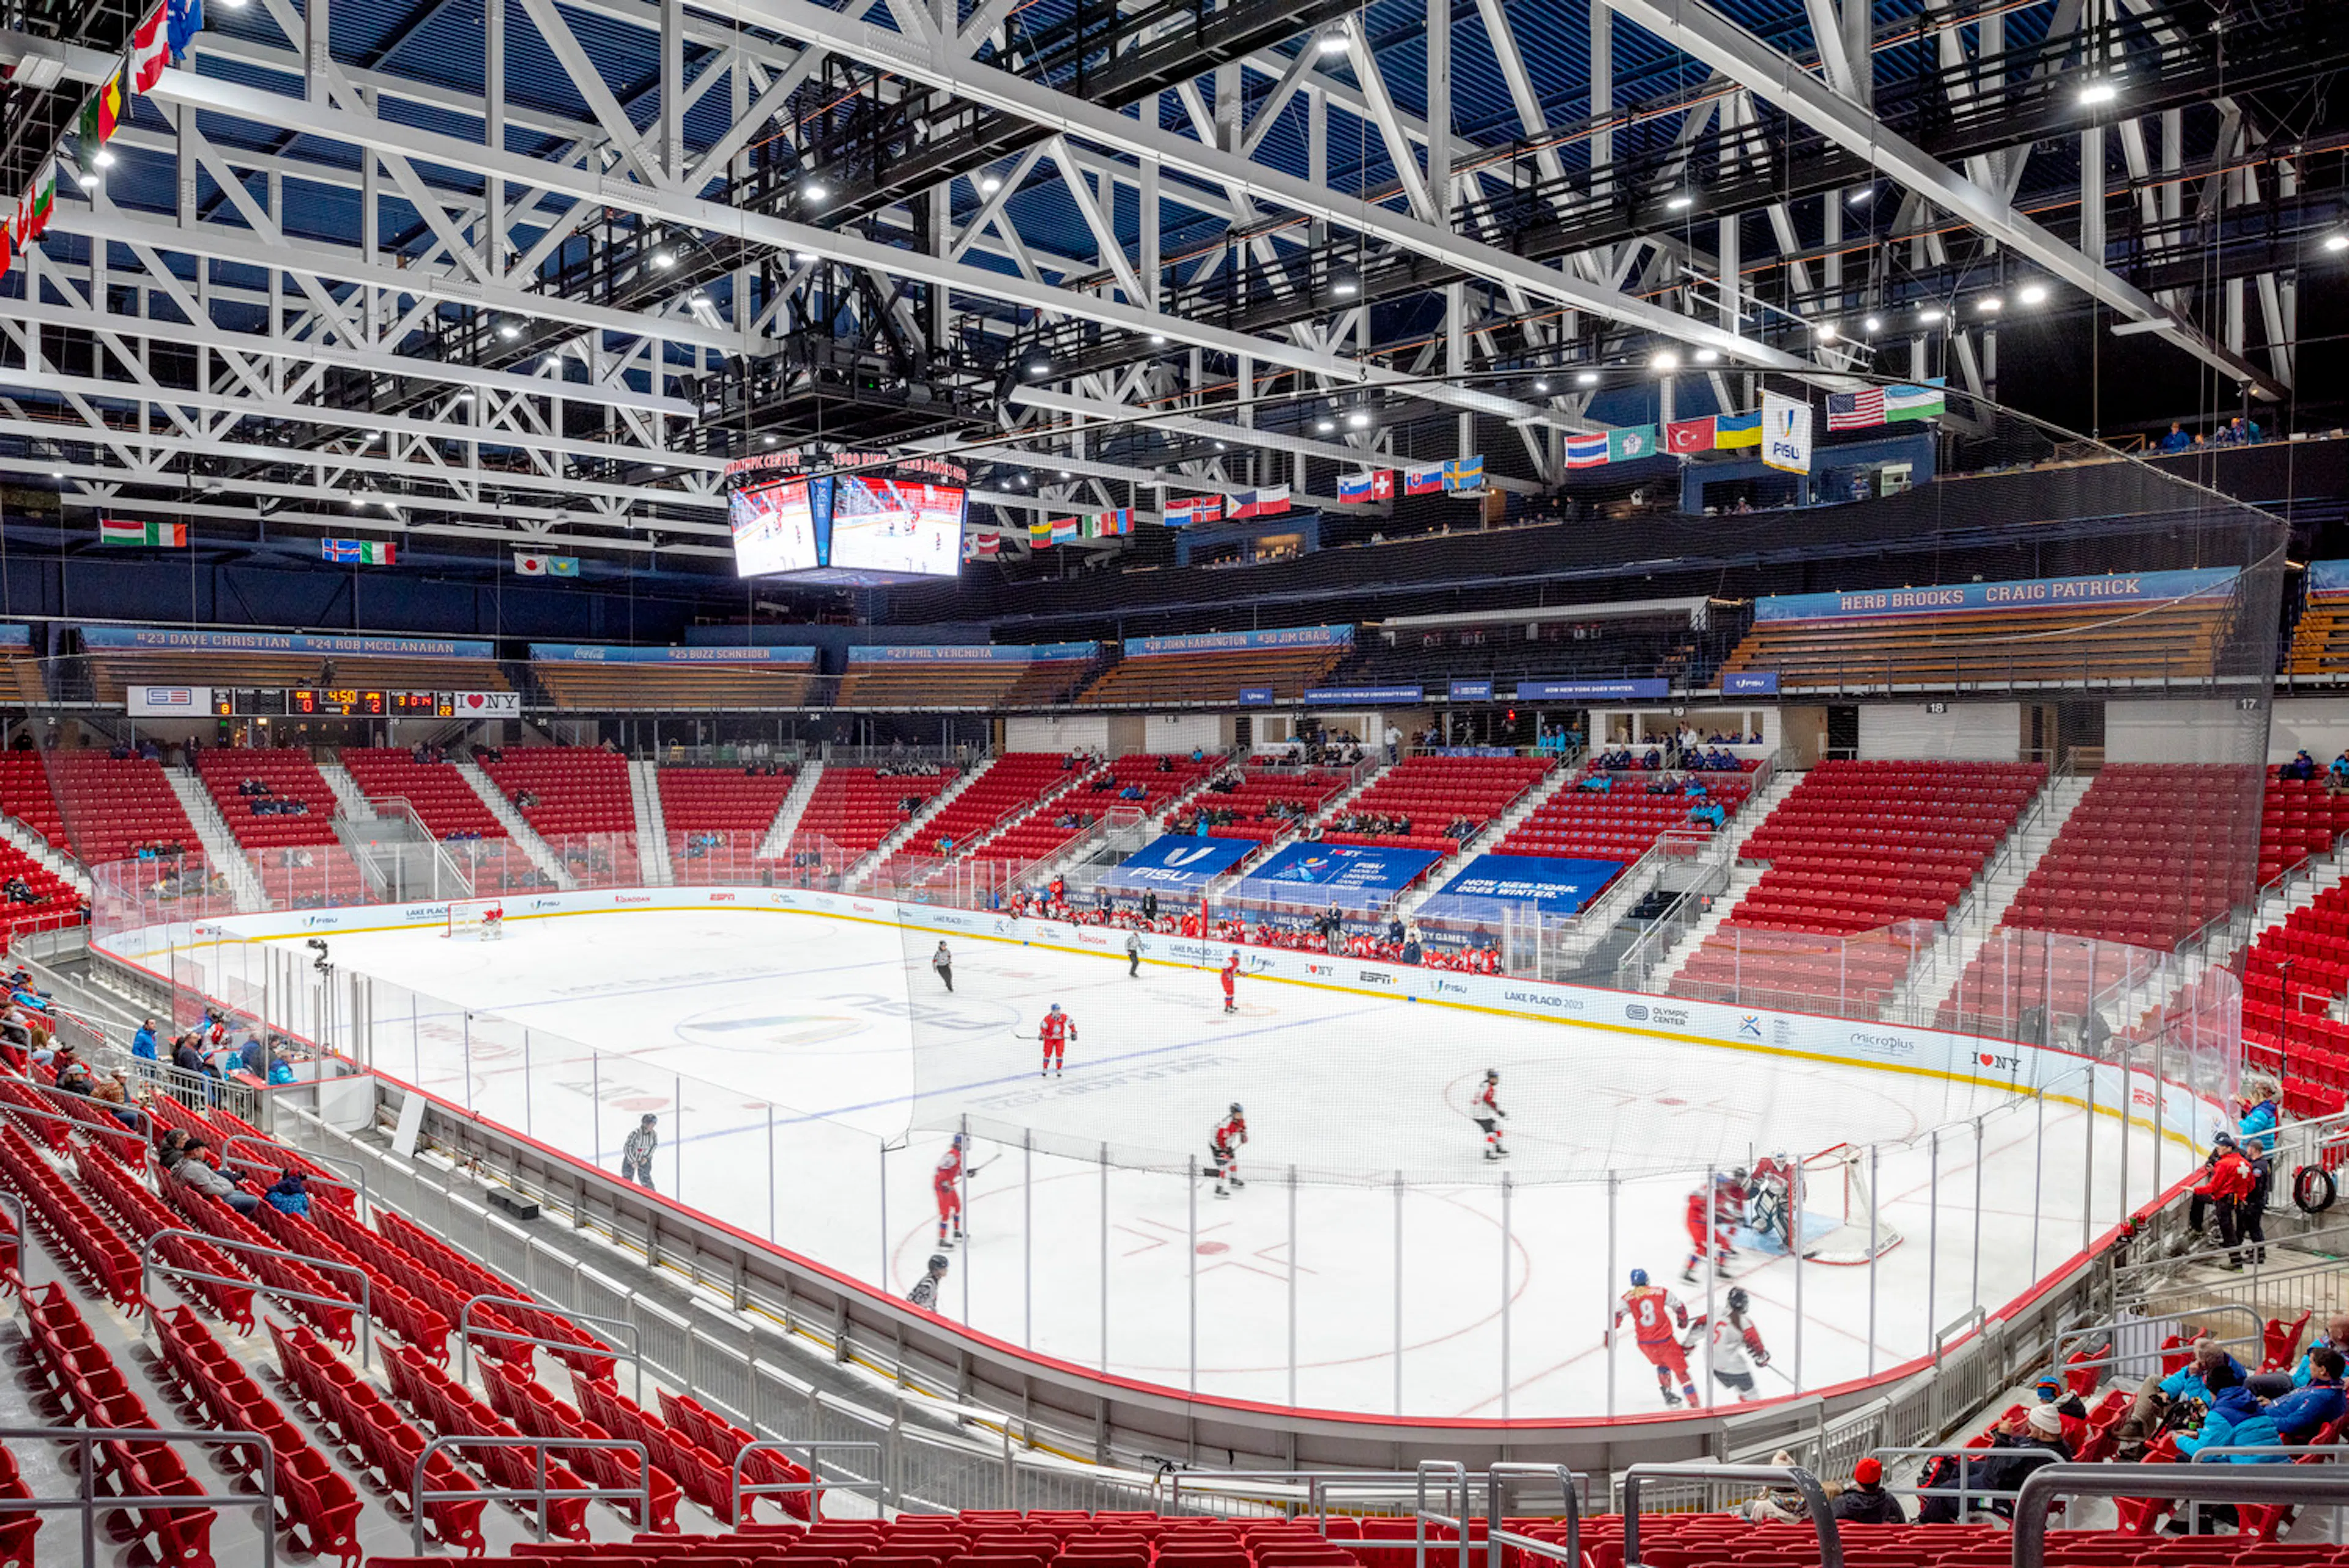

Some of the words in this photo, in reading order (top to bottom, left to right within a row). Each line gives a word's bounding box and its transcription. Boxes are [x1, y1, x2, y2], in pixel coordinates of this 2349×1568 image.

[1774, 442, 1800, 459] FISU
[765, 454, 800, 468] CENTER
[833, 453, 860, 466] 1980
[1841, 595, 1887, 610] HERB
[1892, 590, 1964, 607] BROOKS
[1986, 585, 2045, 602] CRAIG
[2052, 579, 2140, 598] PATRICK
[136, 633, 166, 643] #23
[169, 634, 207, 645] DAVE
[212, 634, 291, 648] CHRISTIAN
[1278, 632, 1297, 642] JIM
[1299, 630, 1330, 641] CRAIG
[306, 639, 331, 649] #24
[336, 640, 361, 650] ROB
[365, 641, 454, 653] MCCLANAHAN
[1163, 639, 1186, 649] JOHN
[1188, 636, 1247, 648] HARRINGTON
[689, 649, 714, 659] BUZZ
[716, 649, 770, 659] SCHNEIDER
[909, 648, 933, 658] PHIL
[937, 648, 992, 658] VERCHOTA
[302, 699, 313, 713] 0
[371, 700, 380, 713] 2
[398, 696, 405, 706] 3
[458, 694, 466, 708] I
[486, 694, 517, 708] NY
[2241, 698, 2257, 709] 17
[221, 704, 230, 715] 8
[342, 705, 350, 715] 2
[439, 705, 452, 716] 22
[1930, 703, 1943, 713] 18
[1129, 867, 1193, 881] FISU
[1536, 882, 1578, 893] YORK
[1436, 932, 1468, 943] GAMES
[1318, 965, 1333, 976] NY
[1444, 983, 1468, 994] FISU
[1504, 991, 1527, 1003] LAKE
[1530, 994, 1562, 1007] PLACID
[1564, 999, 1584, 1009] 2023
[1653, 1008, 1689, 1019] OLYMPIC
[1653, 1016, 1686, 1026] CENTER
[1972, 1052, 1978, 1065] I
[1995, 1055, 2022, 1072] NY
